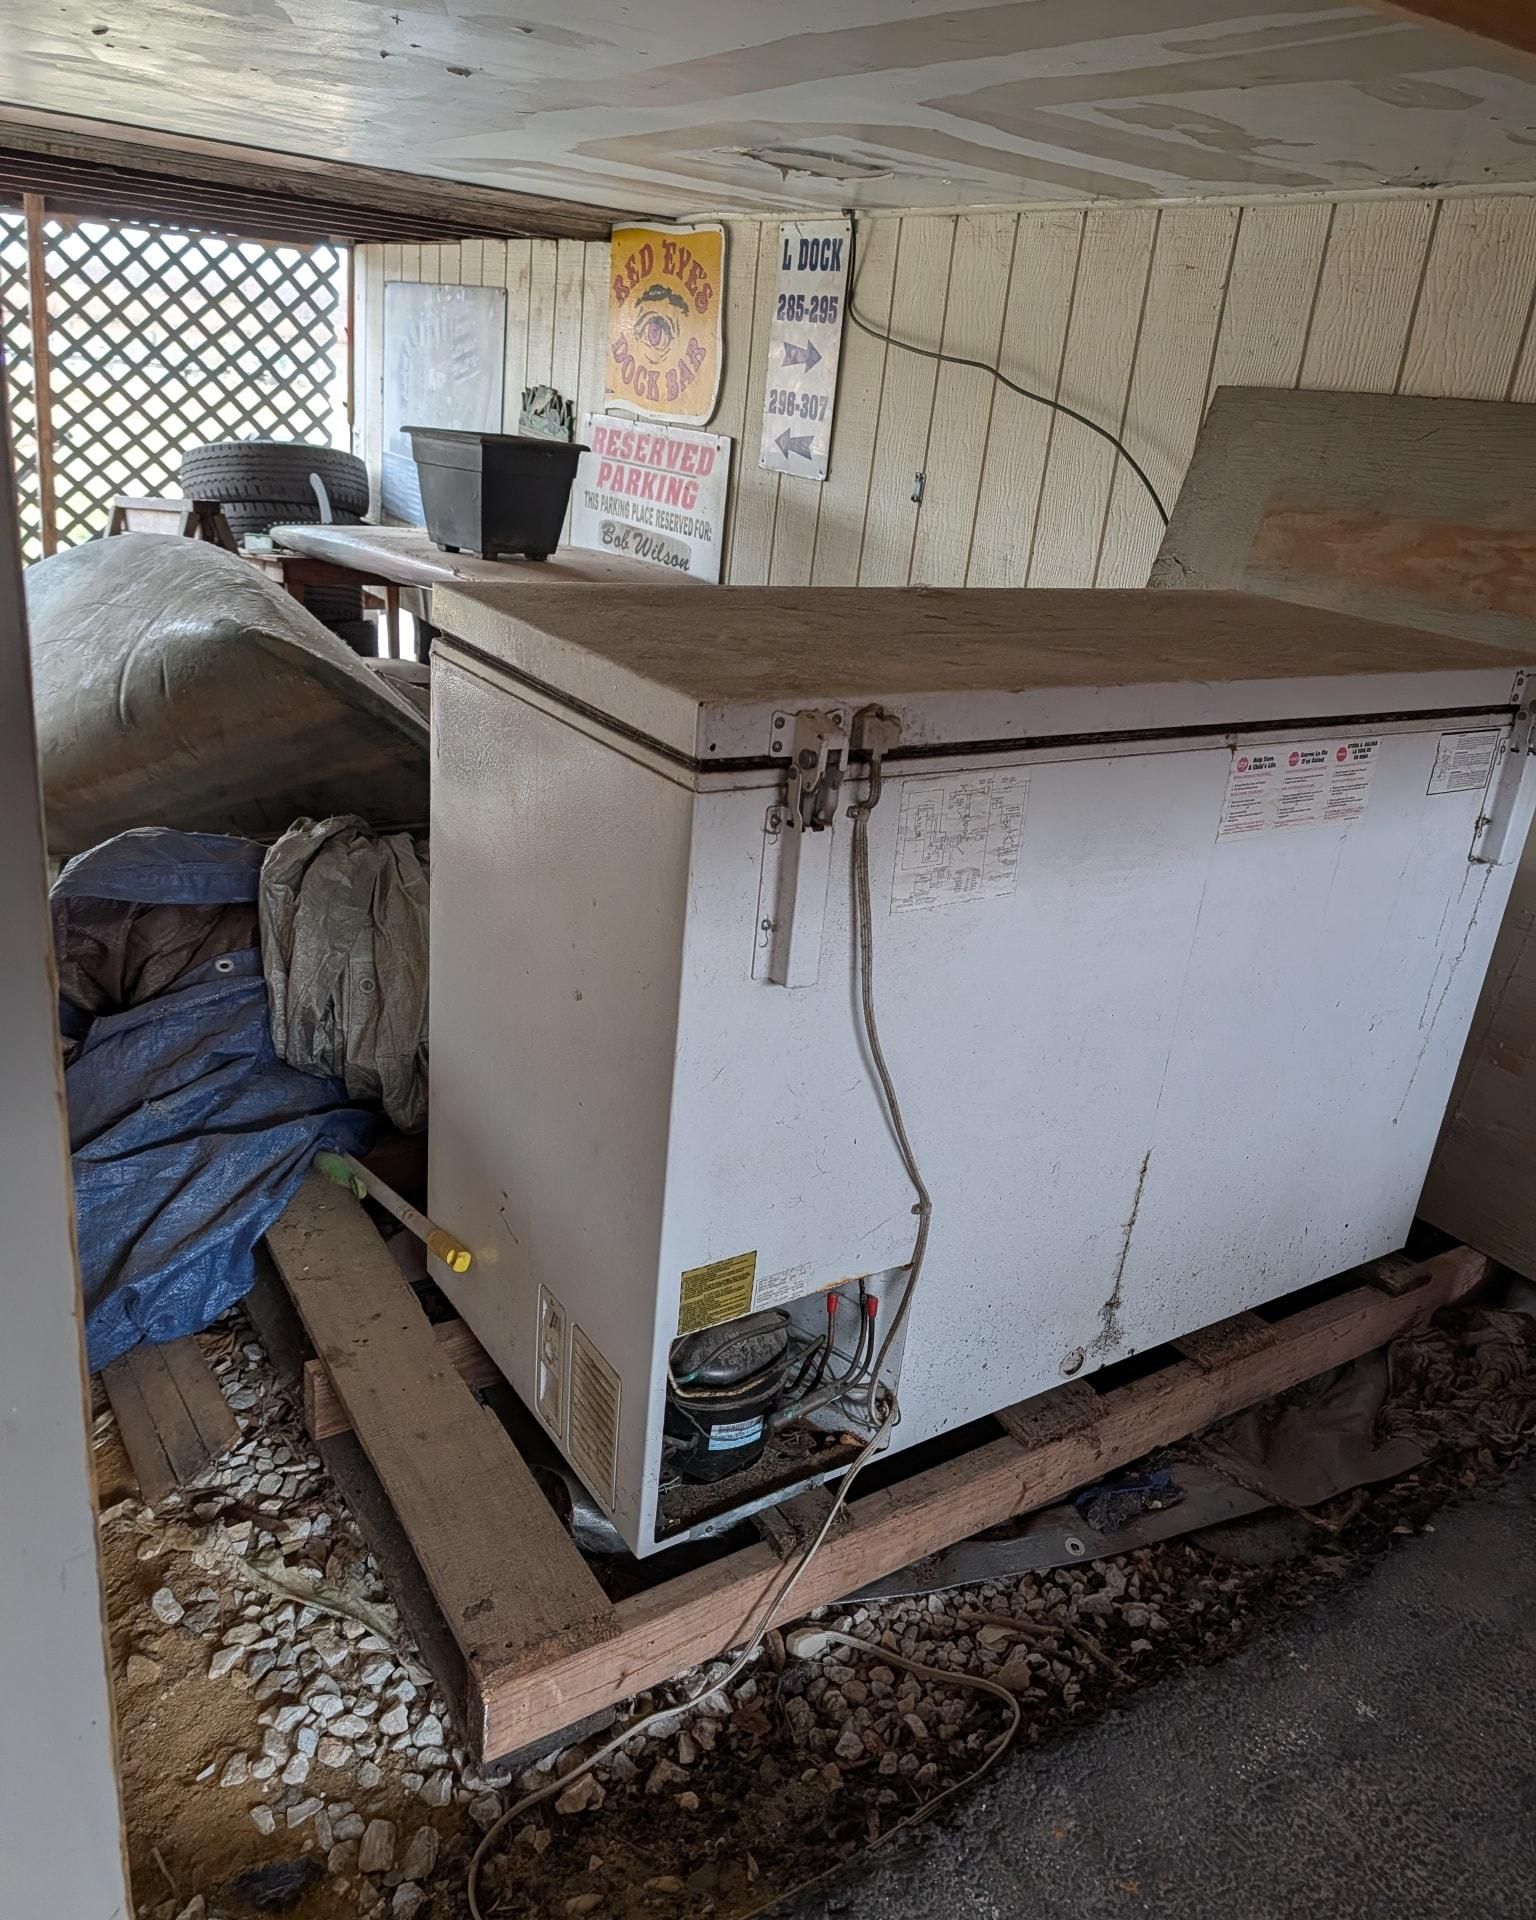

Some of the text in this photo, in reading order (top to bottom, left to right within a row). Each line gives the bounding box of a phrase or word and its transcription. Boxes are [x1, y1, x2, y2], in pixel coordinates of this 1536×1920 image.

[613, 243, 654, 308] RED
[782, 237, 843, 272] L DOCK
[776, 293, 839, 325] 285-295
[611, 332, 707, 402] DOCK BAR
[591, 426, 716, 477] RESERVED
[596, 461, 700, 511] PARKING
[584, 490, 712, 542] THIS PARKING PLACE RESERVED FOR:
[601, 521, 690, 571] Bob Wilson
